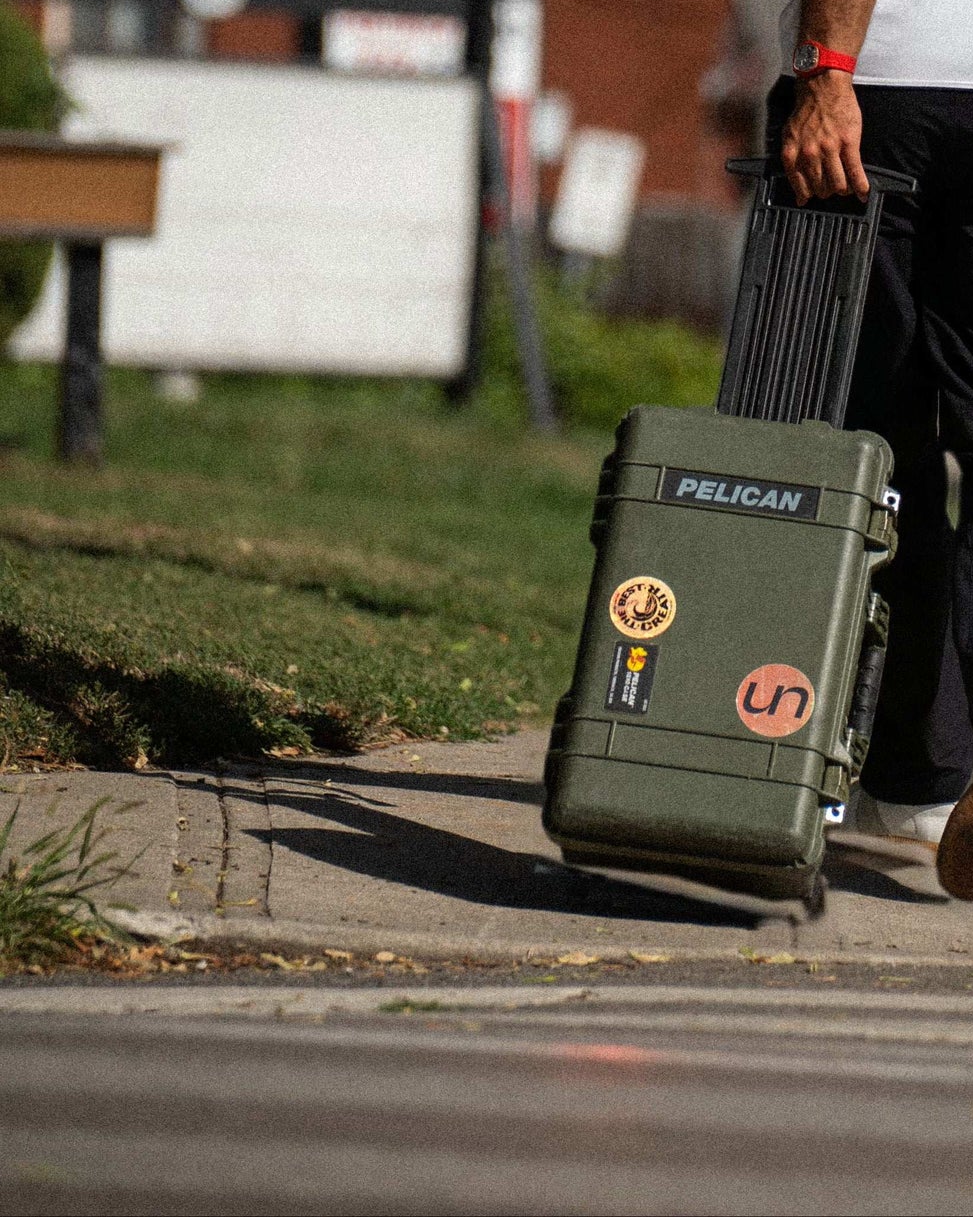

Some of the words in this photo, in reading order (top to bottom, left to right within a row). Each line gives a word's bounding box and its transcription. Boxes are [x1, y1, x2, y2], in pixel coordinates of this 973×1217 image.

[675, 478, 803, 512] PELICAN
[617, 583, 646, 607] BEST
[617, 609, 637, 630] THE
